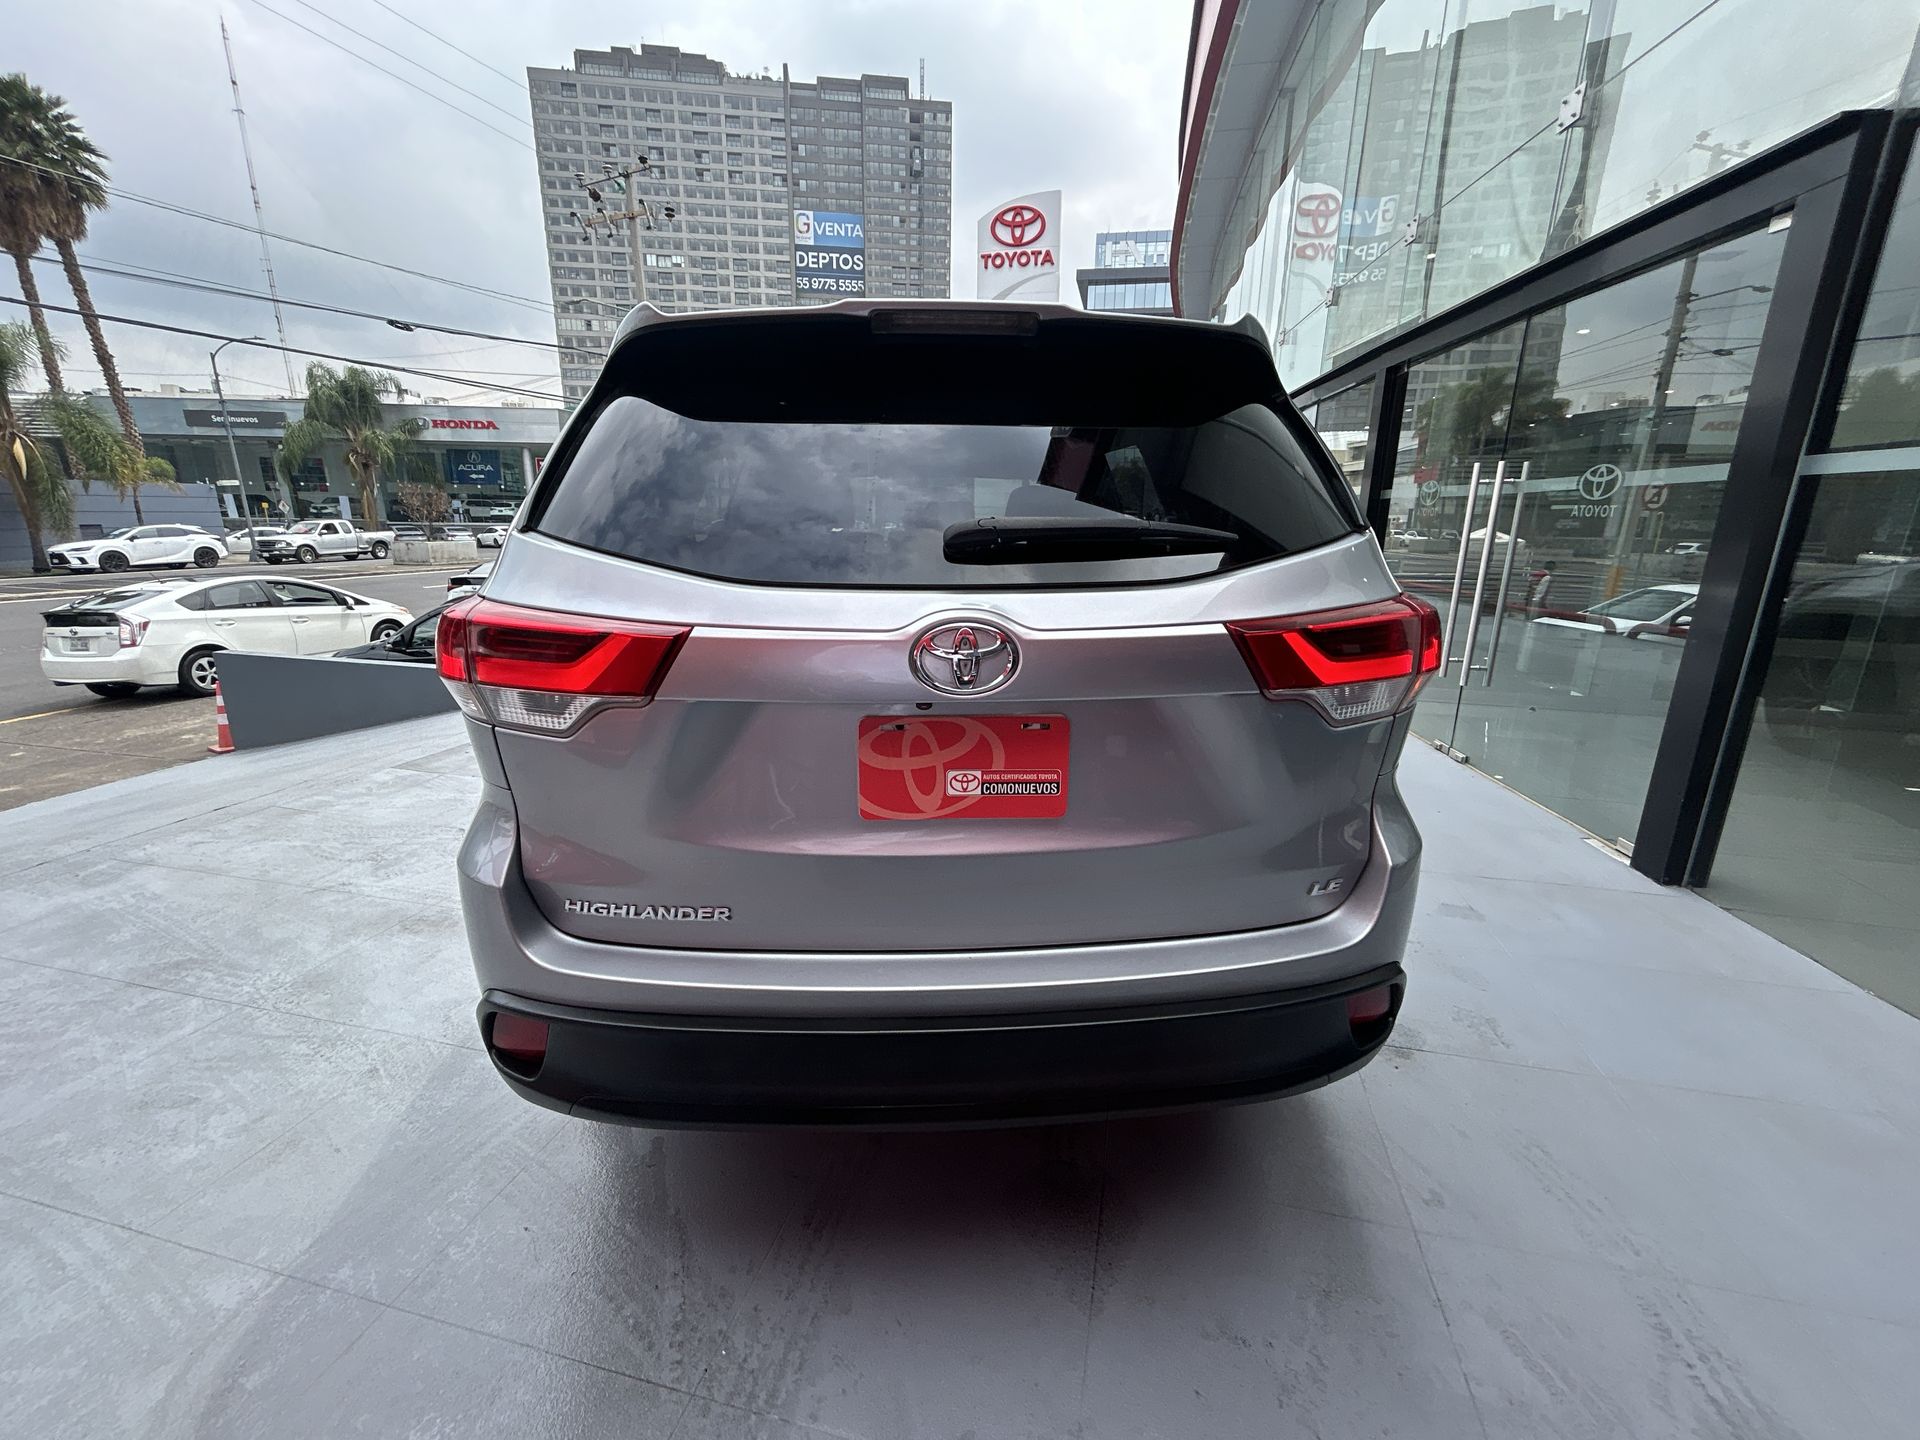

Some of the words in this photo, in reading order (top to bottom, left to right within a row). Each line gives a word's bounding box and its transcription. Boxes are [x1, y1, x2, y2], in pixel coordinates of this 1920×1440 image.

[814, 221, 864, 238] VENTA
[796, 251, 864, 271] DEPTOS
[980, 248, 1055, 270] TOYOTA
[796, 276, 810, 290] 55
[811, 277, 837, 291] 9775
[838, 278, 864, 293] 5555
[431, 419, 499, 430] HONDA
[457, 464, 494, 472] ACURA
[983, 783, 1058, 794] COMONUEVOS
[1309, 876, 1344, 896] LE
[563, 898, 733, 922] HIGHLANDER
